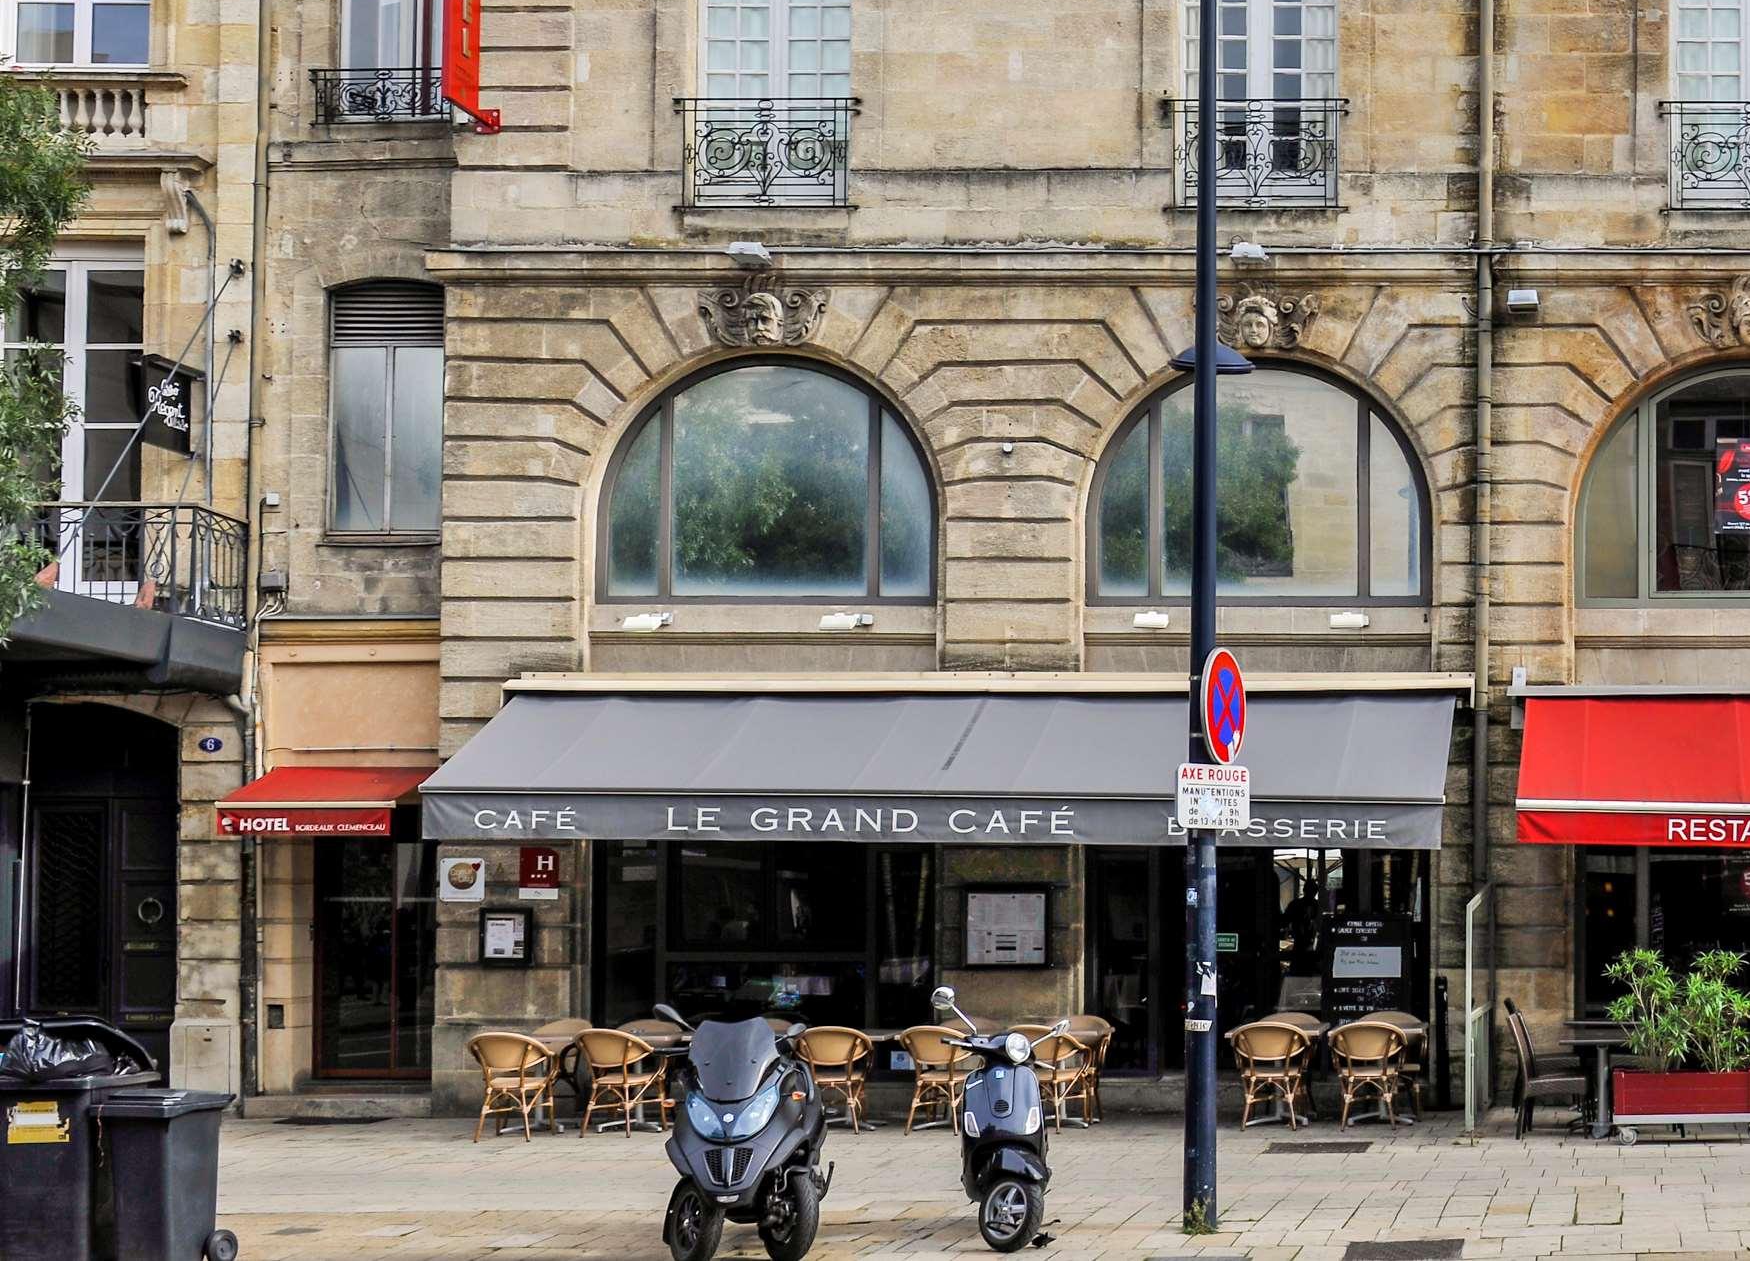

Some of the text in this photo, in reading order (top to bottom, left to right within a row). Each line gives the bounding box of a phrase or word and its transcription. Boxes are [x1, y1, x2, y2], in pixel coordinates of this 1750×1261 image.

[206, 739, 214, 751] 6
[1181, 767, 1247, 782] AXE ROUGE
[473, 806, 577, 831] CAFÉ
[1188, 807, 1199, 816] de
[1229, 808, 1240, 817] 9h
[239, 817, 386, 832] HOTEL BORDEAUX CLEMENCEAU
[666, 805, 1076, 835] LE GRAND CAFÉ
[1188, 818, 1199, 826] de
[1225, 818, 1240, 826] 19h
[1167, 816, 1387, 840] BSSERIE
[537, 855, 554, 871] H
